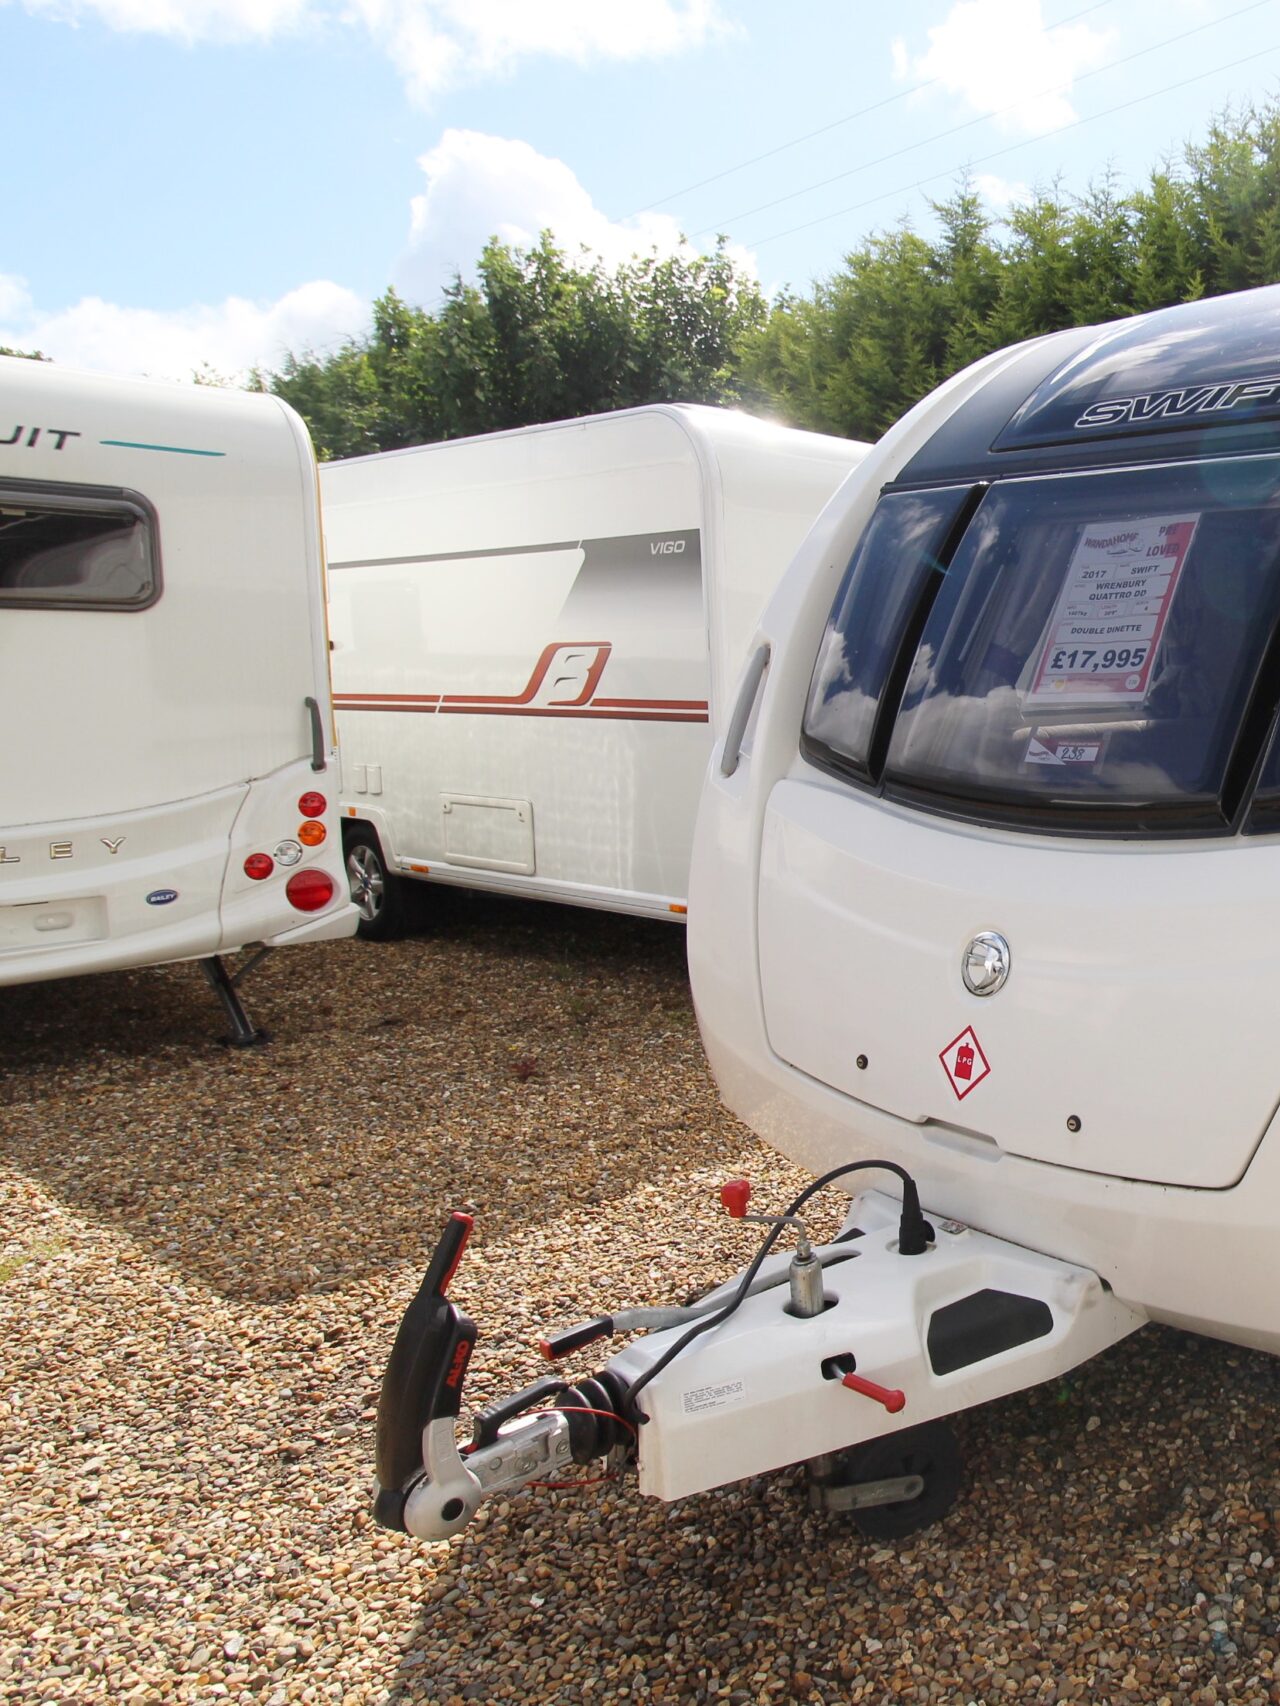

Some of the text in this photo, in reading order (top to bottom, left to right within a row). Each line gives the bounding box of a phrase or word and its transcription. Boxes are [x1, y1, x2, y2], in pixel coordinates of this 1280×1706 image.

[650, 540, 685, 555] VIGO
[1146, 543, 1180, 557] LOVED
[1082, 570, 1106, 579] 2017
[1131, 565, 1160, 575] SWIFT
[1096, 579, 1147, 590] WRENBURY
[1089, 589, 1147, 601] QUATTRO DD
[1071, 624, 1142, 635] DOUBLE DINETTE
[1051, 648, 1146, 673] £17,995
[957, 1055, 972, 1066] LPG
